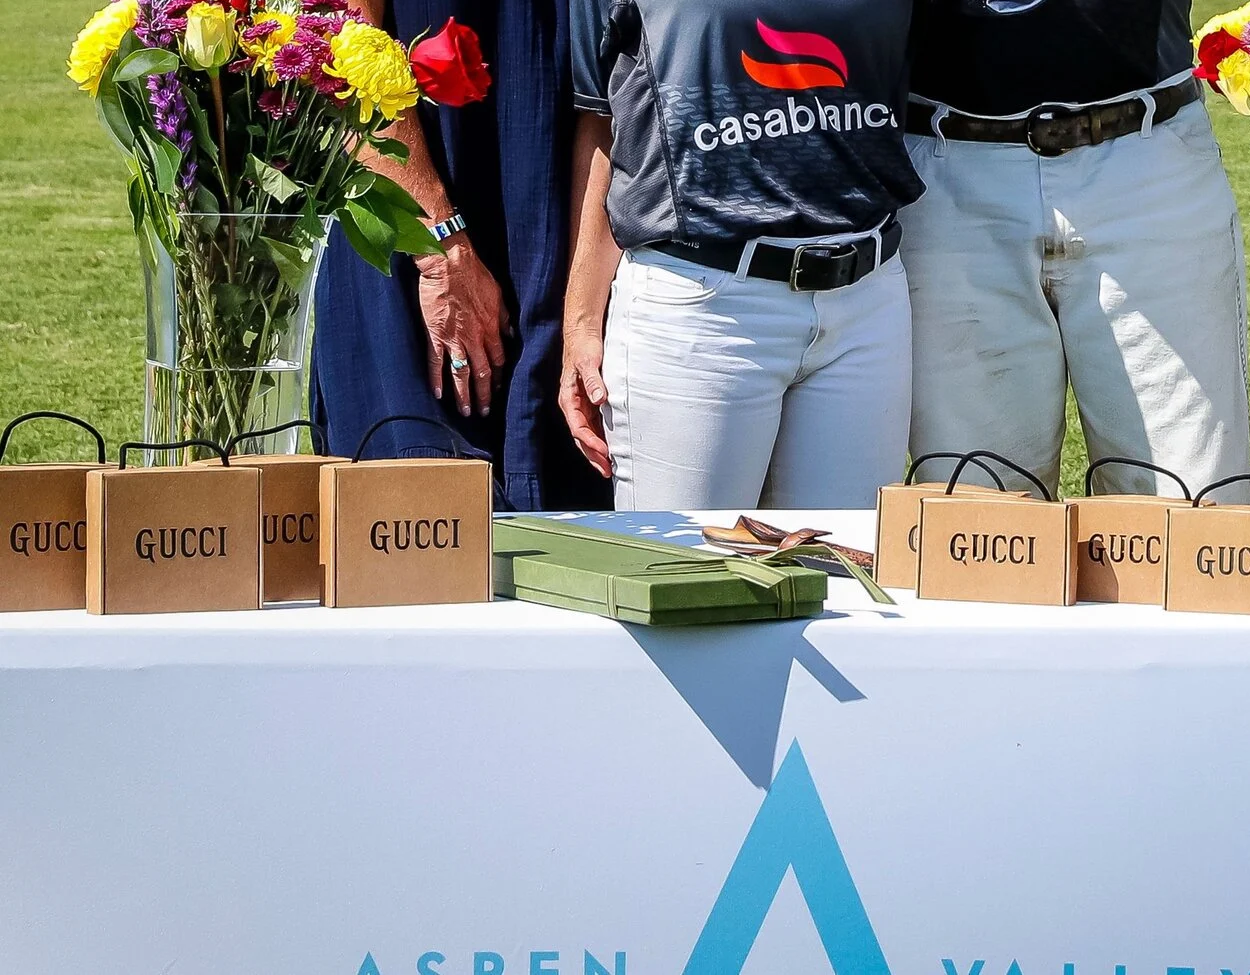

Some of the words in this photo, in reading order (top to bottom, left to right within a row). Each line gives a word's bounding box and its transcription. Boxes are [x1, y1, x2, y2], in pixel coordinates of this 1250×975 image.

[10, 521, 86, 556] GUCC
[135, 526, 228, 563] GUCCI
[263, 514, 319, 544] UCC
[370, 518, 461, 554] GUCCI
[950, 532, 1036, 566] GUCCI
[1088, 534, 1161, 566] GUCC
